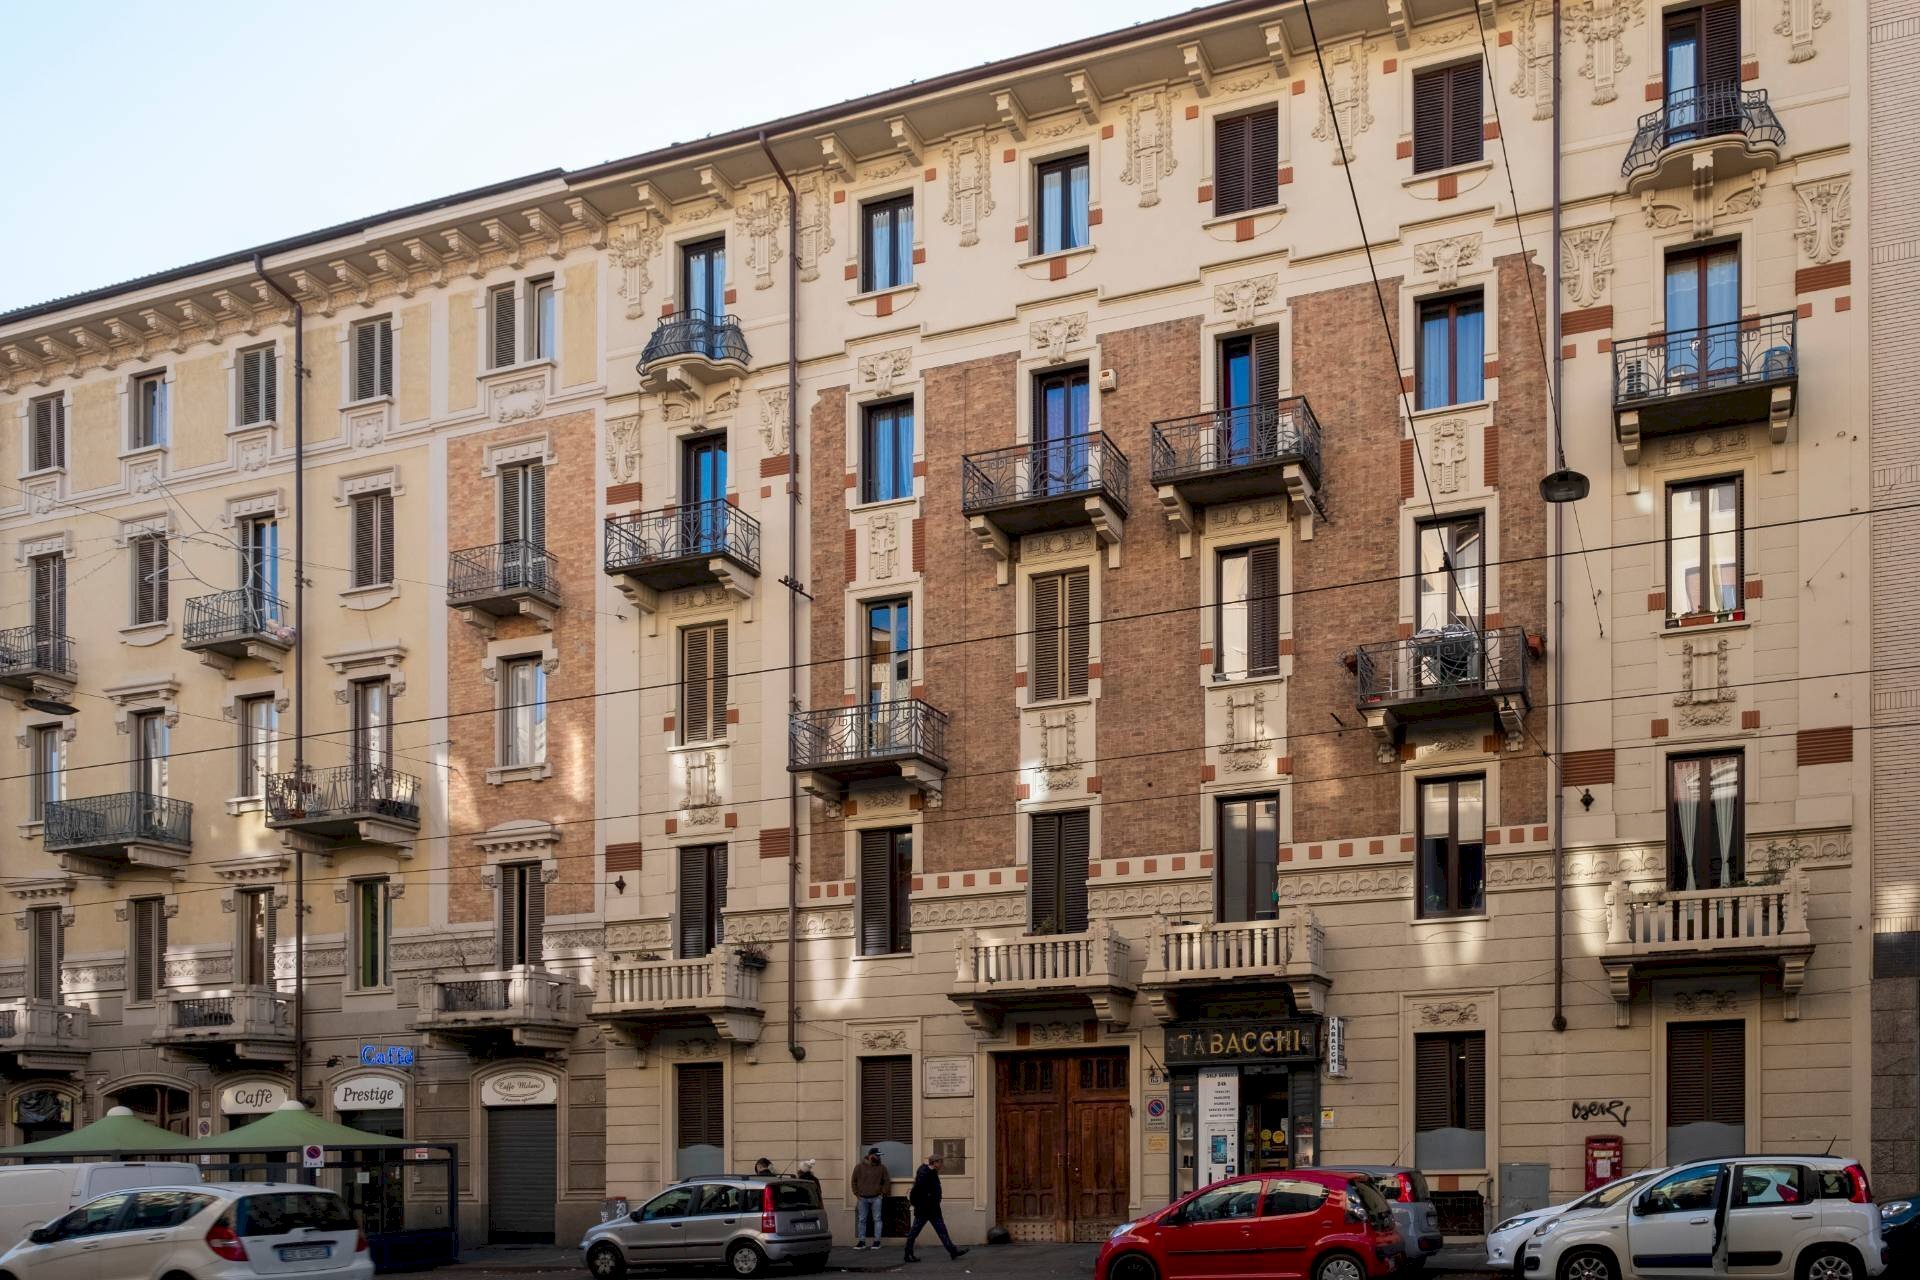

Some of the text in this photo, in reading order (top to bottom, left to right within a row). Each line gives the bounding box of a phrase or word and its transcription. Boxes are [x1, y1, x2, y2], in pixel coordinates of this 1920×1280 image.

[1177, 1029, 1301, 1056] TABACCHI
[235, 1088, 273, 1107] Caffè
[343, 1087, 394, 1105] Prestige
